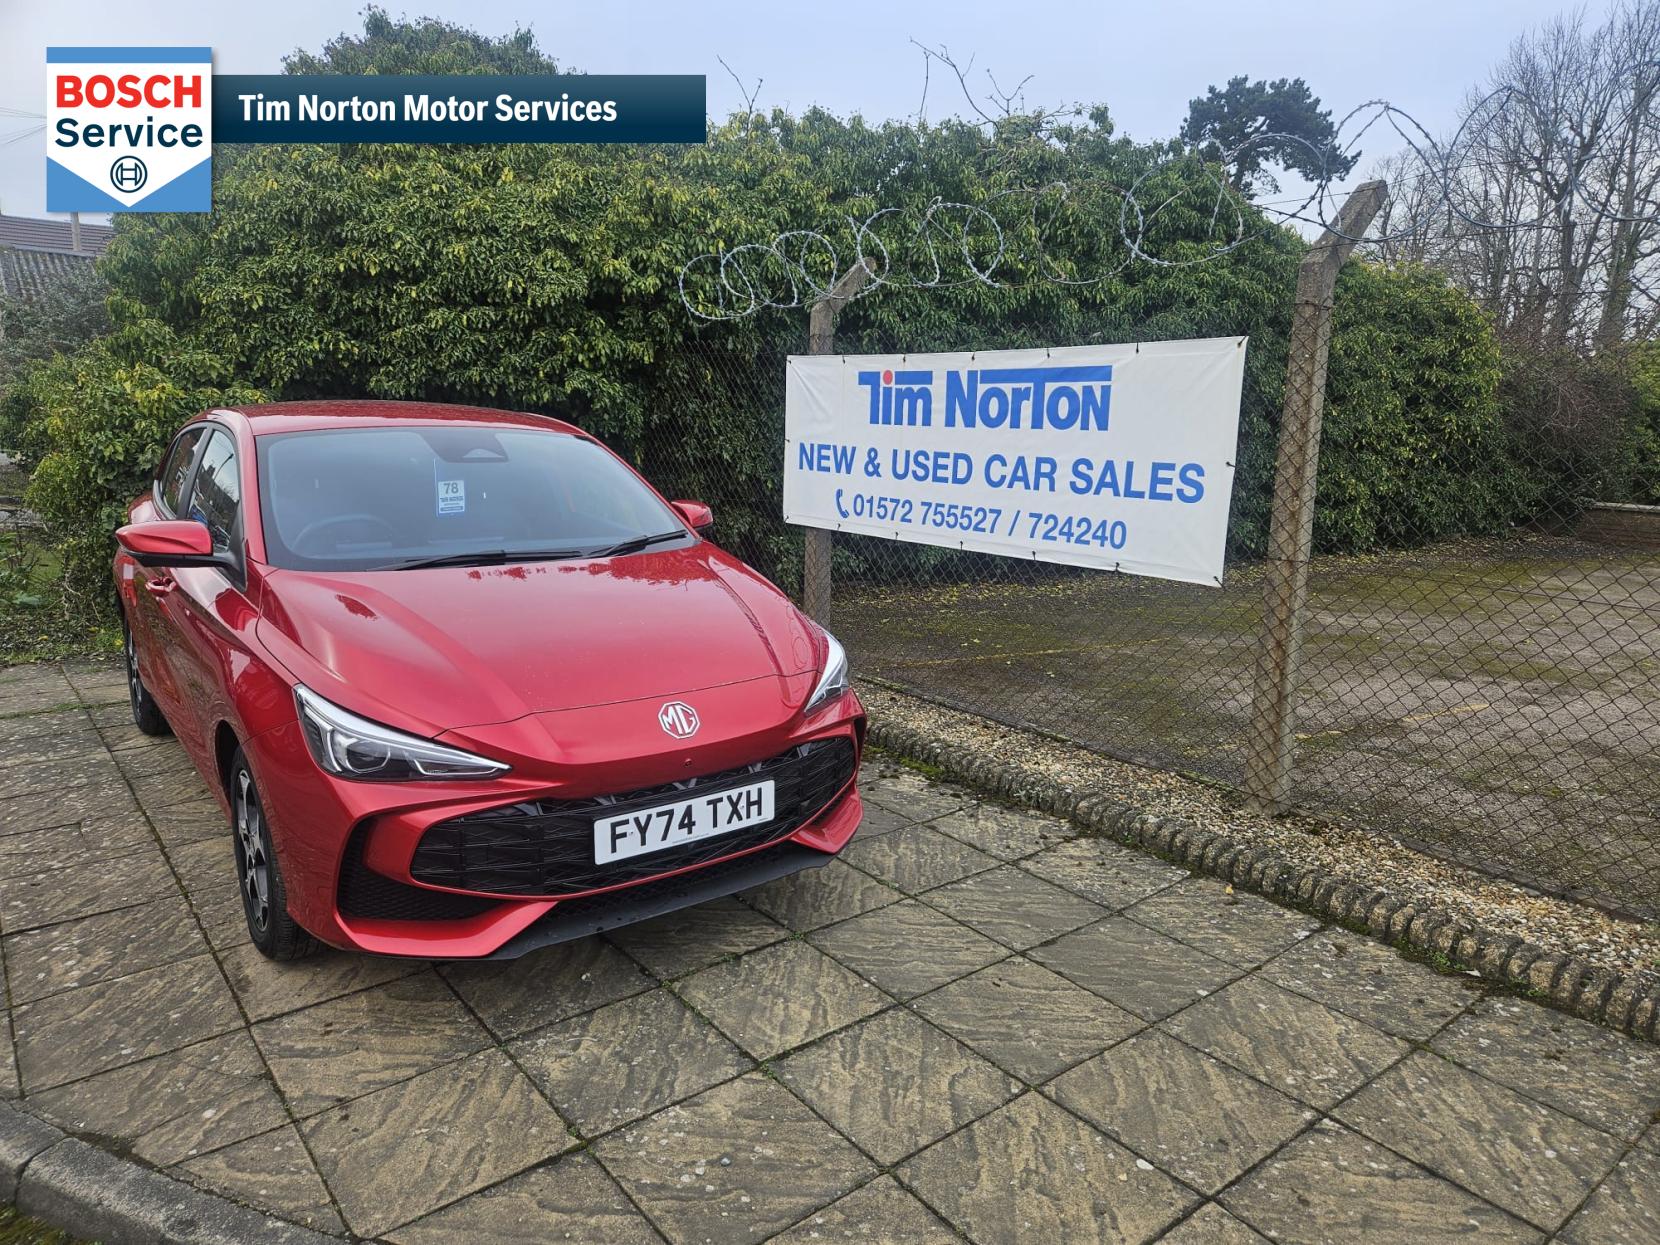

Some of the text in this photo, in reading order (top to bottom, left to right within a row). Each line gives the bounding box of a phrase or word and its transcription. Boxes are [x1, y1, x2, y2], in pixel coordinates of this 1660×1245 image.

[858, 369, 933, 427] Tim
[443, 482, 459, 494] 78
[798, 442, 1206, 504] NEW & USED CAR SALES
[852, 493, 1128, 550] 01572 755527 / 724240
[661, 703, 697, 736] MG
[610, 787, 763, 853] FY74 TXH
